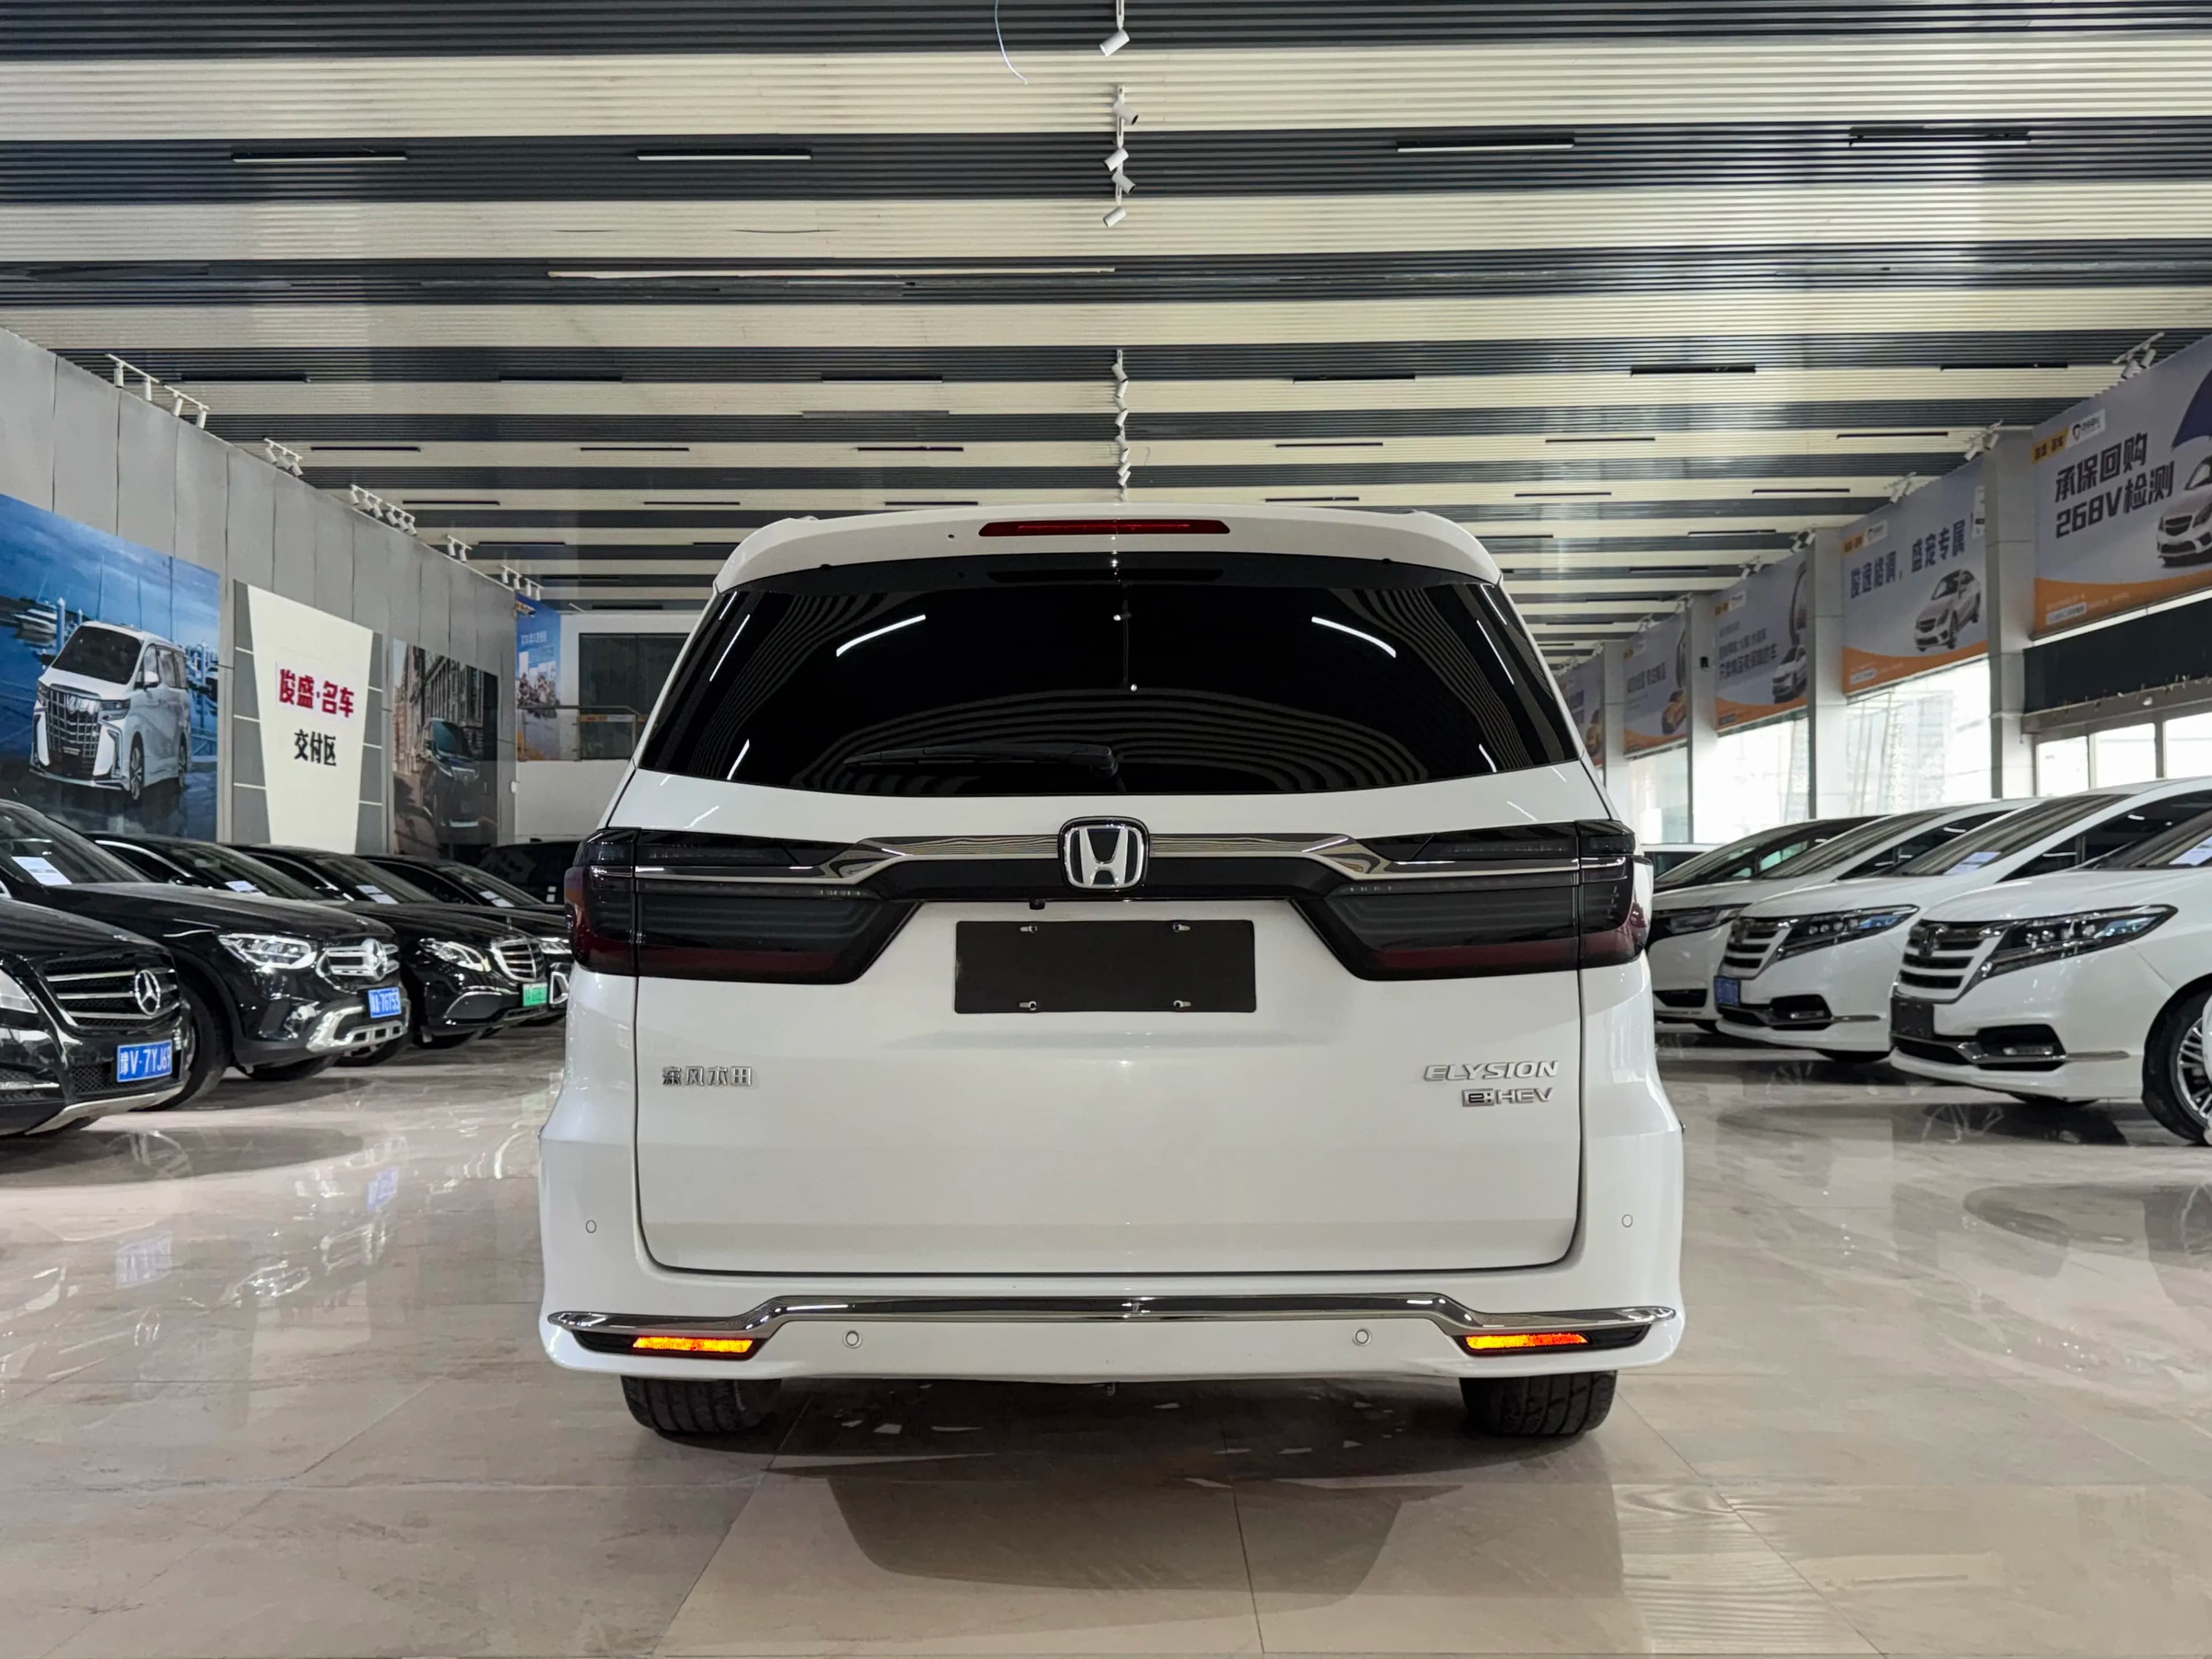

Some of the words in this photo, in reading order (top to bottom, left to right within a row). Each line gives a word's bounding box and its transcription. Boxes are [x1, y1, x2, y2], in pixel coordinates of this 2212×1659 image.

[2055, 433, 2147, 503] 承保回购
[2056, 460, 2175, 539] 268V检测
[294, 729, 337, 767] 交付区
[662, 1066, 751, 1086] 东风本田
[1423, 1060, 1560, 1082] ELYSION
